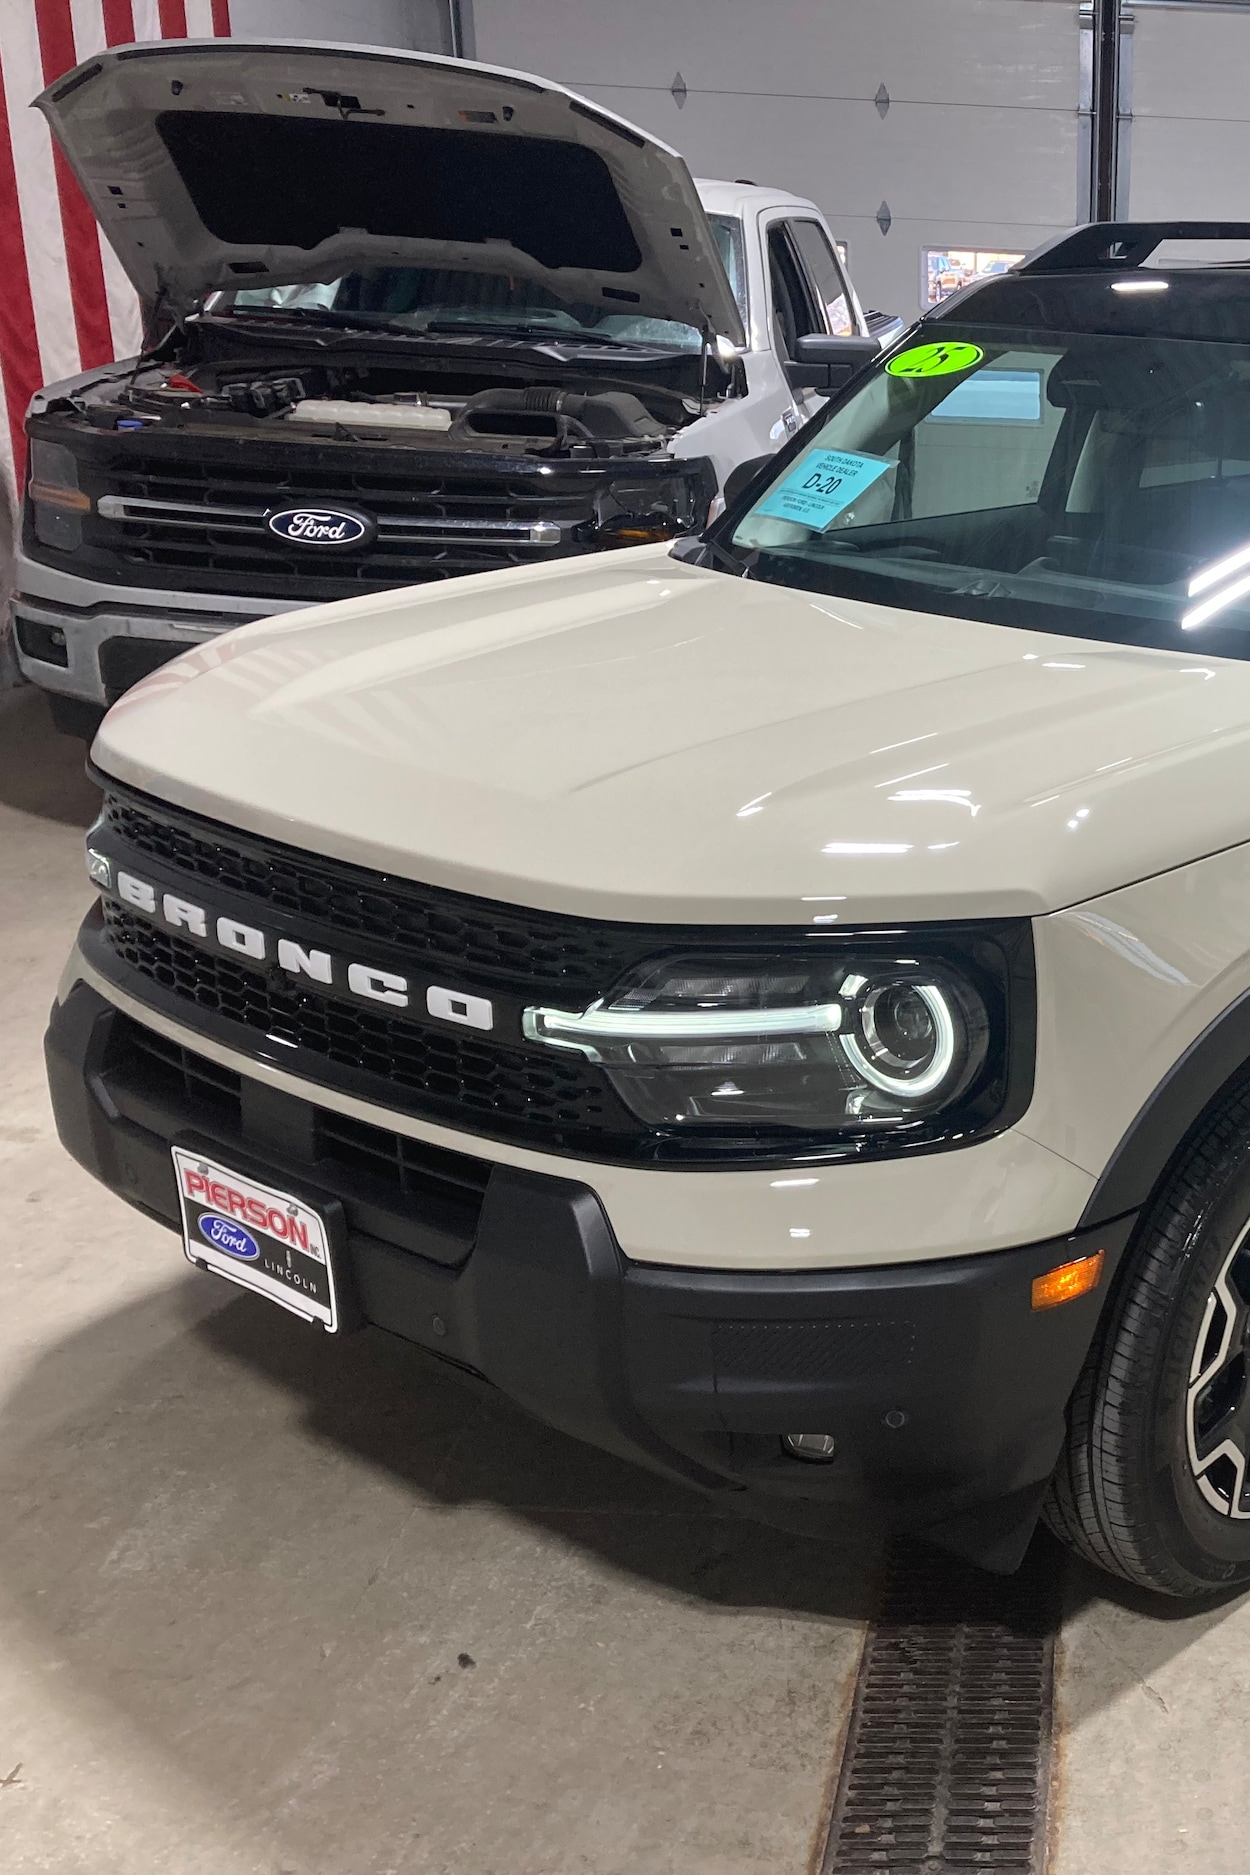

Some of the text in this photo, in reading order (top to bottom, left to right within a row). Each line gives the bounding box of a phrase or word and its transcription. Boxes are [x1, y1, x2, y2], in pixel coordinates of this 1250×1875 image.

[899, 346, 968, 373] 25
[815, 462, 858, 477] VEHICLE DEALER
[825, 454, 864, 468] SOUTH DAKOTA
[801, 473, 843, 495] D-20
[288, 513, 346, 539] Ford
[117, 871, 494, 1031] BRONCO
[184, 1167, 310, 1252] PIERSON
[210, 1219, 248, 1253] Ford
[264, 1258, 318, 1294] LINCOLN
